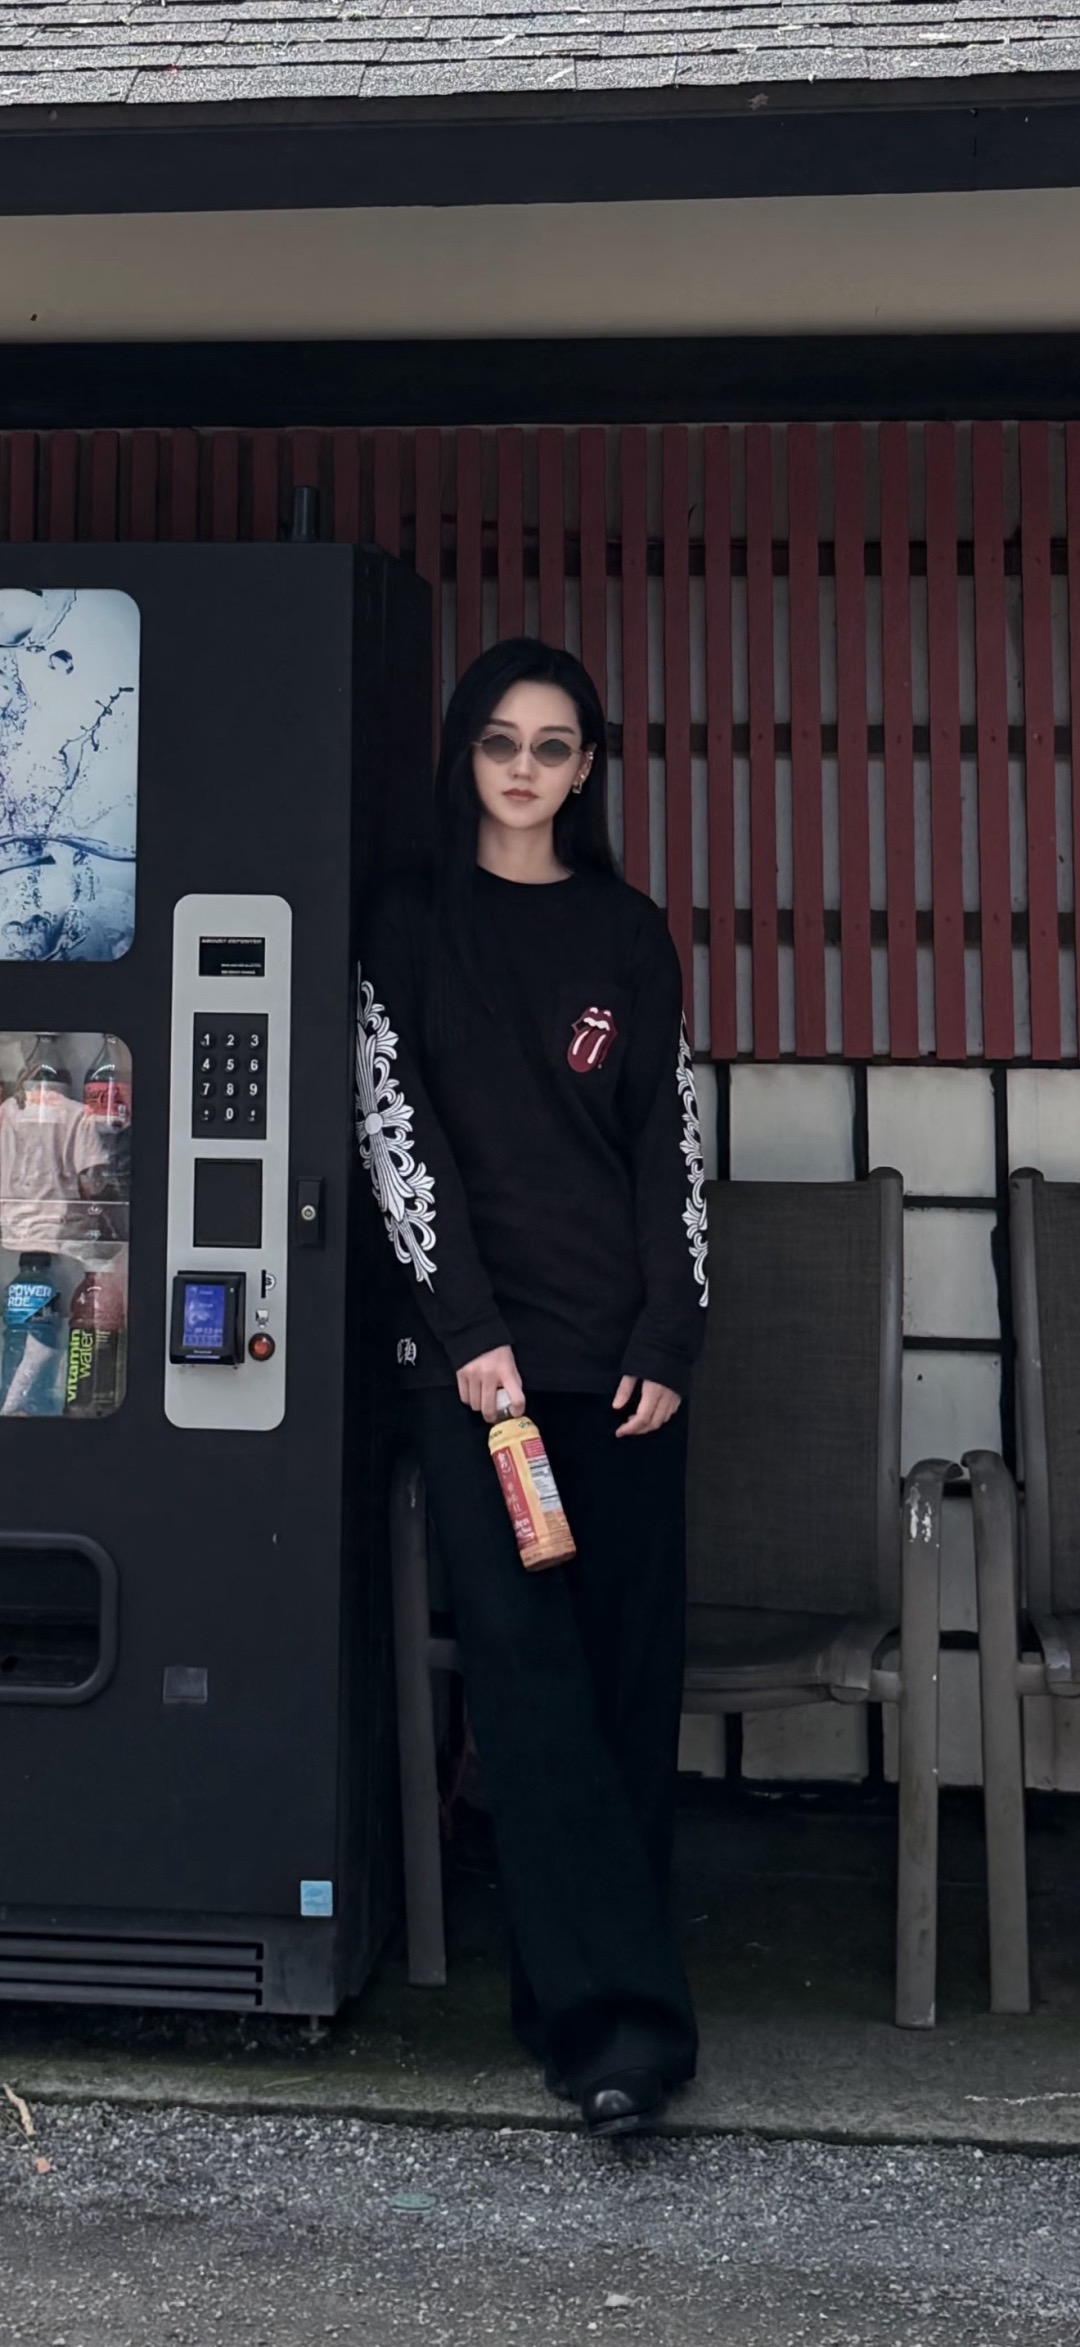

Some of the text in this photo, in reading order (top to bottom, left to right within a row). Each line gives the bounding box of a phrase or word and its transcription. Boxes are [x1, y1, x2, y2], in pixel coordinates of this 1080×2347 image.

[203, 1033, 259, 1047] 1 2 3
[202, 1058, 259, 1071] 4 5 6
[202, 1082, 258, 1096] 7 8 9
[225, 1107, 234, 1120] 0
[8, 1284, 52, 1297] POWER
[79, 1329, 94, 1379] water
[67, 1328, 81, 1402] vitamin
